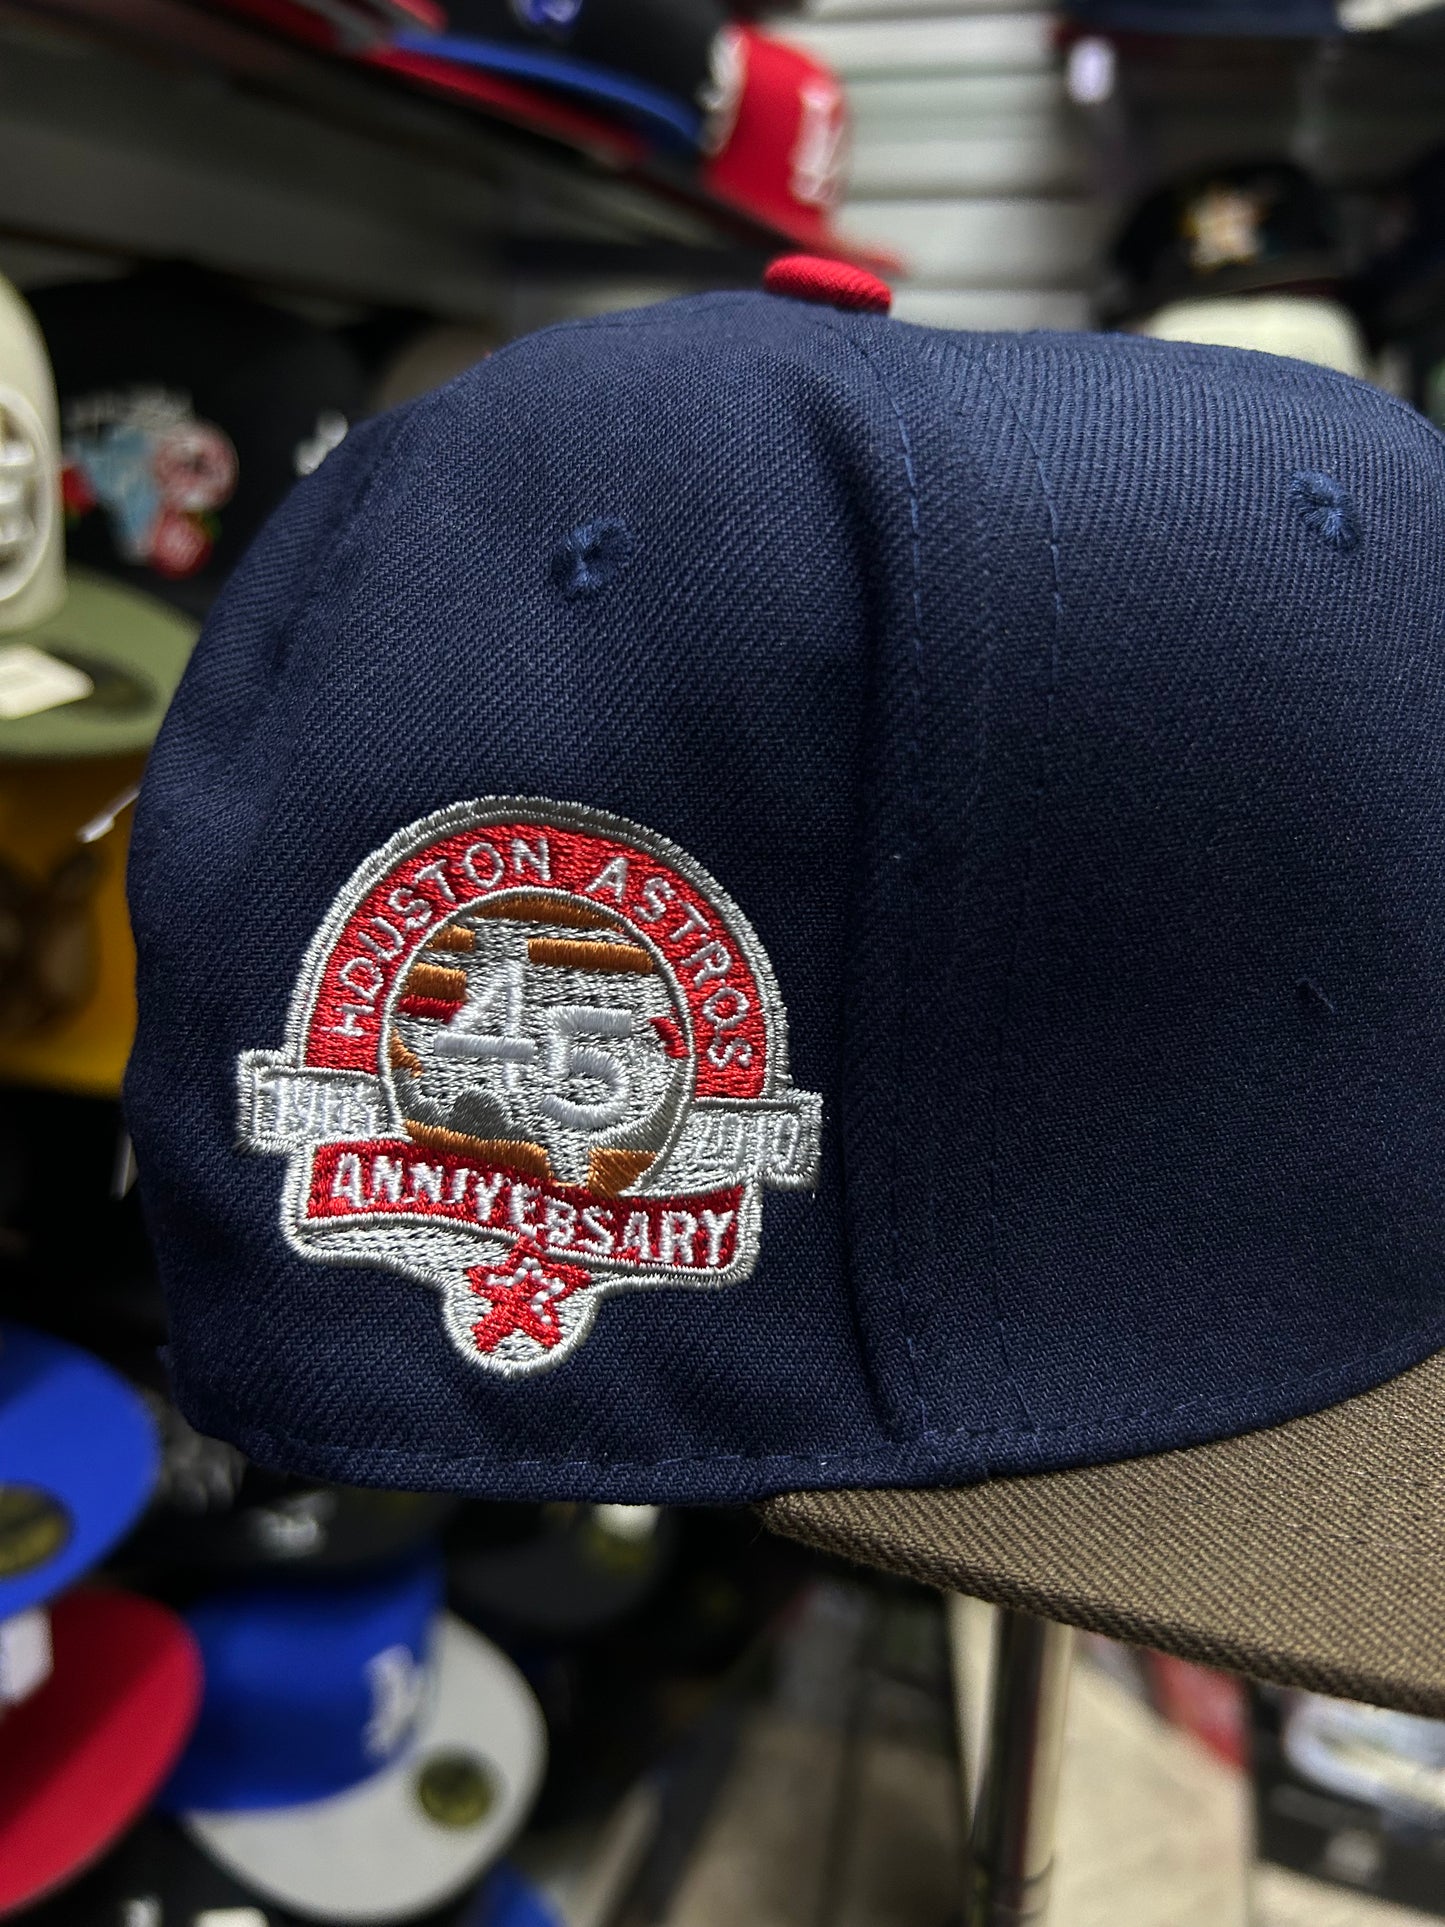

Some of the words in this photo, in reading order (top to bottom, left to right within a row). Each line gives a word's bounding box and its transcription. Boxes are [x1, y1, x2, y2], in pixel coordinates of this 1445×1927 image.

[326, 837, 552, 1037] HOUSTON
[584, 857, 753, 1069] ASTROS
[433, 958, 633, 1130] 45
[331, 1151, 735, 1267] ANNIVERSARY
